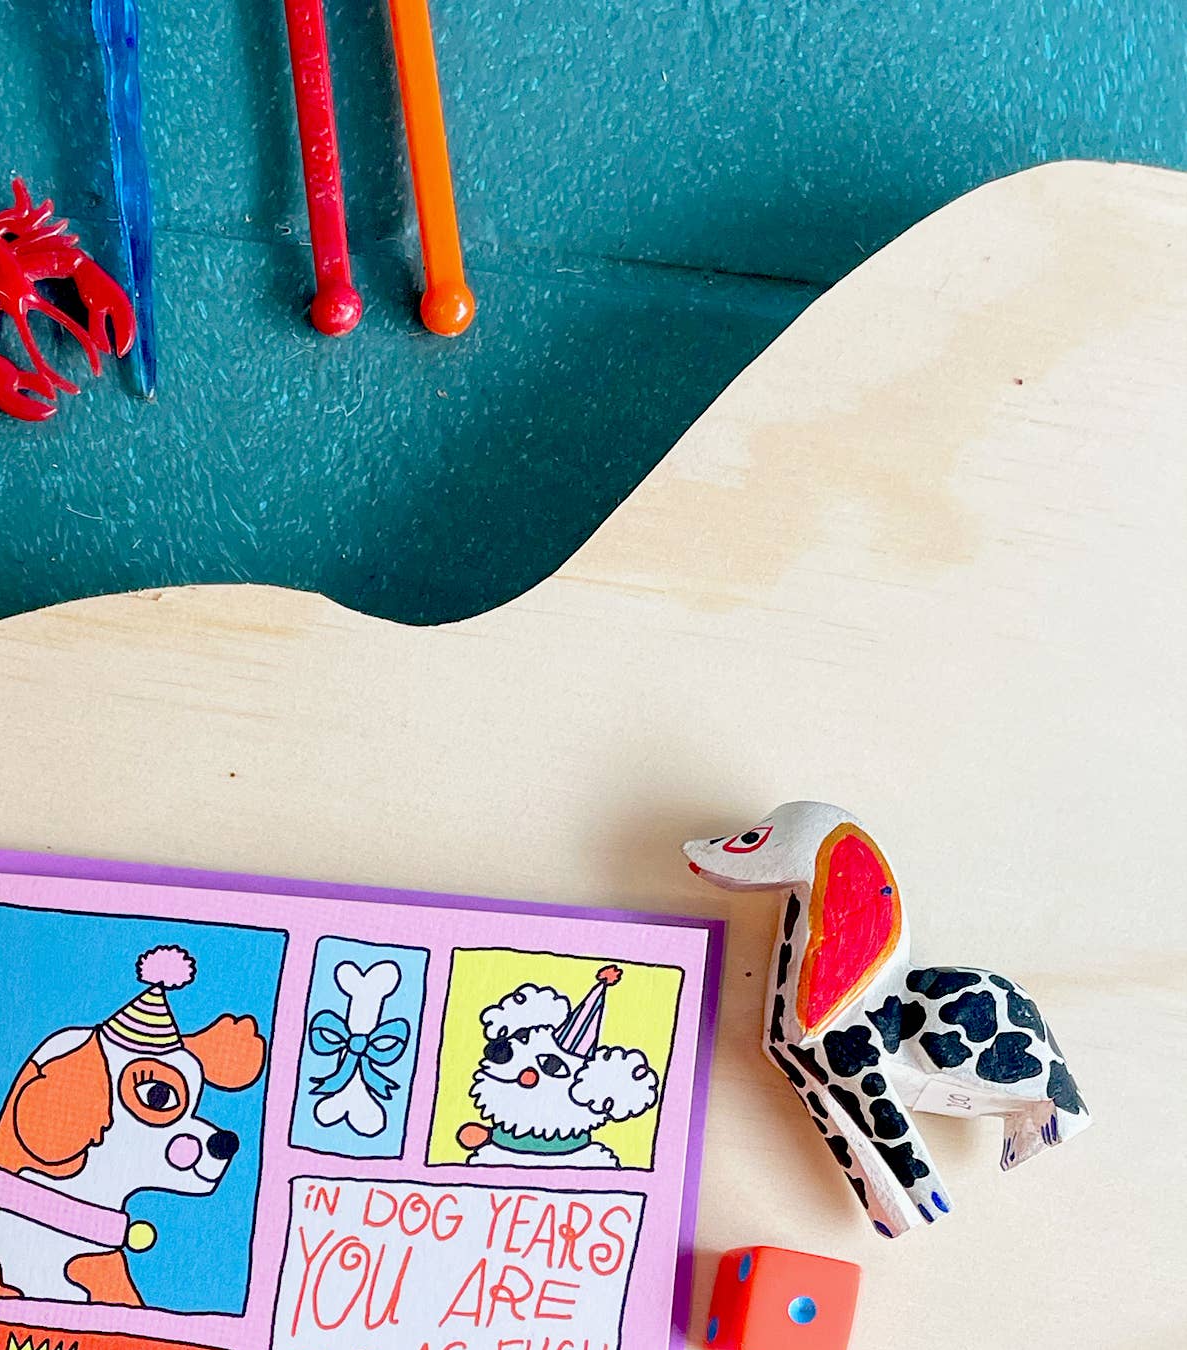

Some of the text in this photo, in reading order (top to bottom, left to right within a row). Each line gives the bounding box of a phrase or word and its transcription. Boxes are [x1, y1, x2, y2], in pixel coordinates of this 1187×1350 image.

[291, 1226, 581, 1337] YOU ARE
[363, 1188, 464, 1241] DOG
[486, 1193, 632, 1276] YEARS
